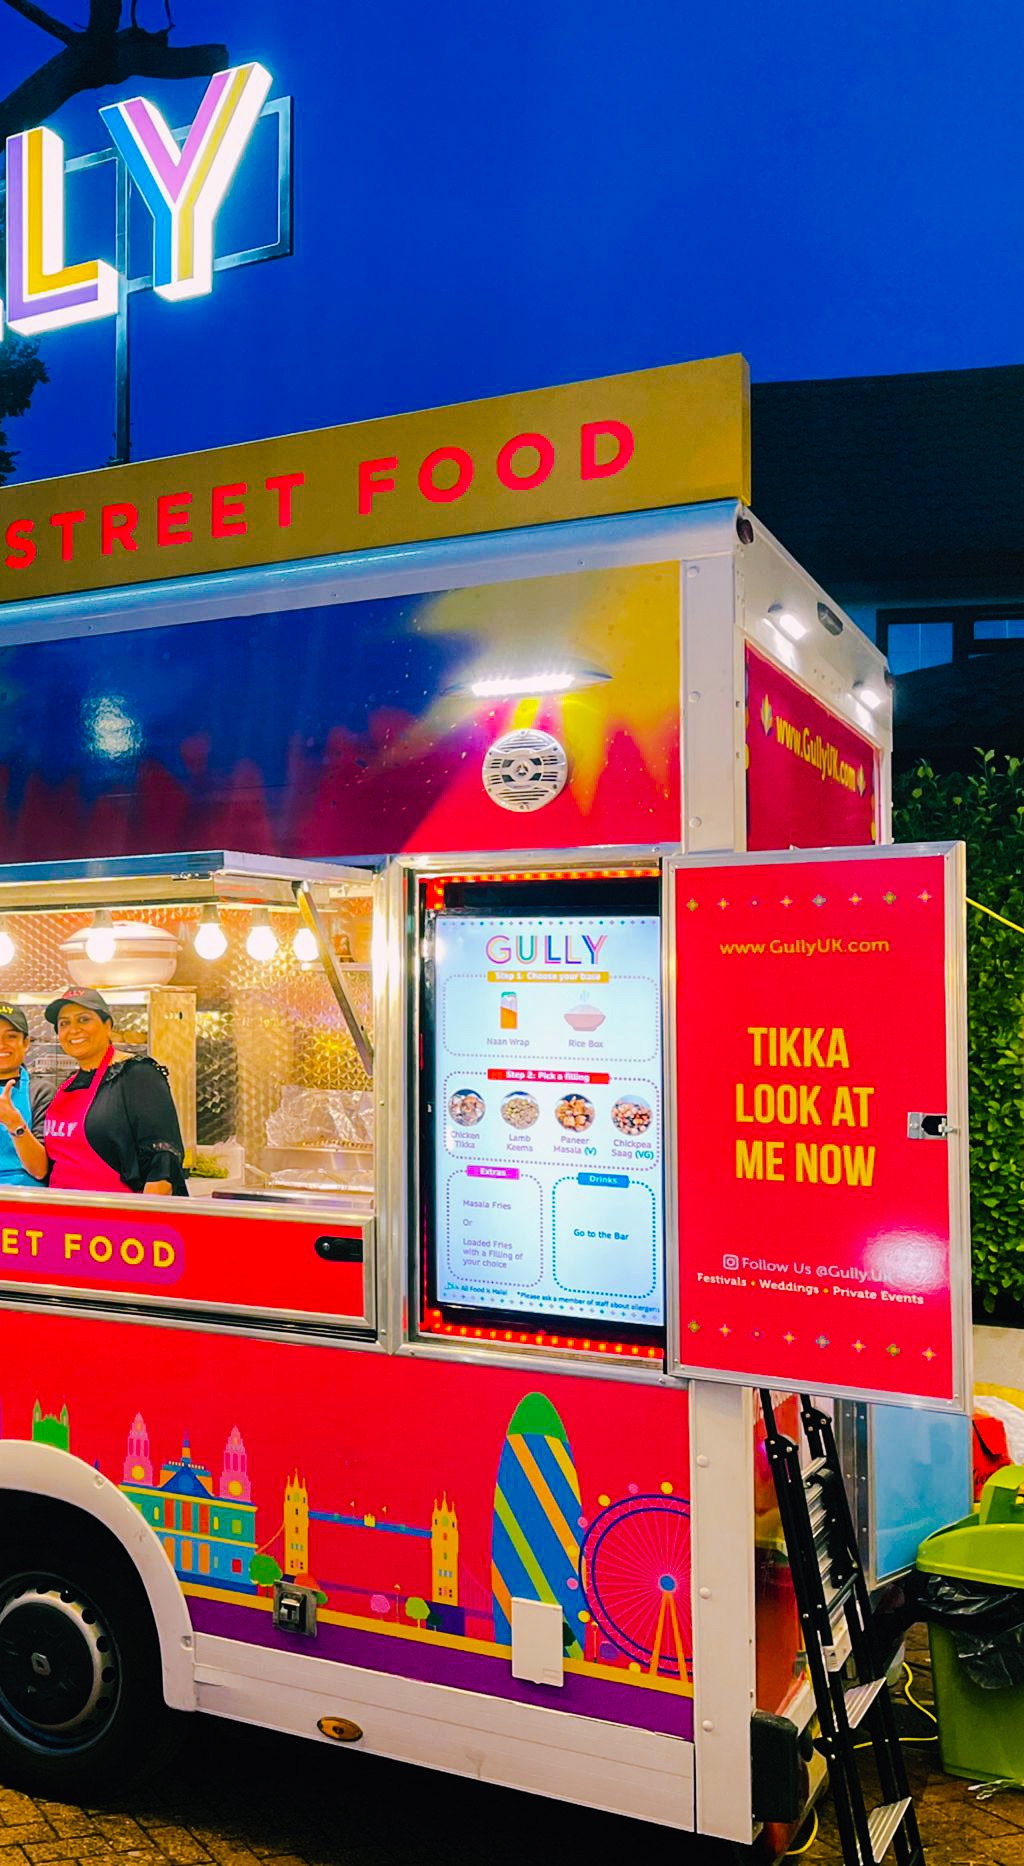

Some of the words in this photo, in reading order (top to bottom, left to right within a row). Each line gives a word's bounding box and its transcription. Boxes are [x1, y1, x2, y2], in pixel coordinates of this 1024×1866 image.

[4, 472, 305, 571] STREET
[358, 418, 635, 515] FOOD
[776, 715, 856, 793] www.GullyUK.com
[485, 935, 608, 965] GULLY
[486, 1038, 508, 1047] Naan
[509, 1038, 530, 1048] Wrap
[568, 1039, 586, 1048] Rice
[588, 1039, 604, 1048] Box
[747, 1026, 850, 1069] TIKKA
[505, 1070, 526, 1081] Step
[527, 1071, 536, 1080] 2:
[537, 1071, 556, 1081] Pick
[564, 1073, 590, 1083] filling
[735, 1083, 822, 1126] LOOK
[831, 1085, 875, 1128] AT
[43, 1119, 78, 1138] ULLY
[451, 1130, 480, 1140] Chicken
[508, 1133, 531, 1143] Lamb
[560, 1135, 590, 1145] Paneer
[455, 1139, 476, 1149] Tikka
[506, 1143, 534, 1152] Keema
[613, 1138, 652, 1150] Chickpea
[553, 1145, 582, 1155] Masala
[584, 1146, 597, 1157] (V)
[611, 1149, 633, 1160] Saag
[634, 1149, 655, 1161] (VG)
[735, 1139, 785, 1182] ME
[795, 1142, 876, 1187] NOW
[479, 1167, 507, 1177] Extras
[588, 1174, 619, 1185] Drinks
[462, 1199, 490, 1209] Masala
[491, 1201, 512, 1210] Fries
[462, 1218, 473, 1227] Or
[573, 1228, 585, 1238] Go
[587, 1230, 597, 1238] to
[597, 1230, 612, 1240] the
[613, 1231, 630, 1241] Bar
[462, 1238, 491, 1248] Loaded
[493, 1240, 513, 1250] Fries
[63, 1233, 176, 1269] FOOD
[462, 1247, 479, 1257] with
[514, 1252, 524, 1261] of
[462, 1258, 481, 1267] your
[482, 1259, 507, 1269] choice
[742, 1256, 789, 1274] Follow
[793, 1261, 812, 1276] Us
[697, 1272, 748, 1288] Festivals
[759, 1278, 820, 1296] Weddings
[832, 1285, 877, 1301] Private
[880, 1290, 925, 1305] Events
[558, 1296, 585, 1305] member
[610, 1301, 630, 1310] about
